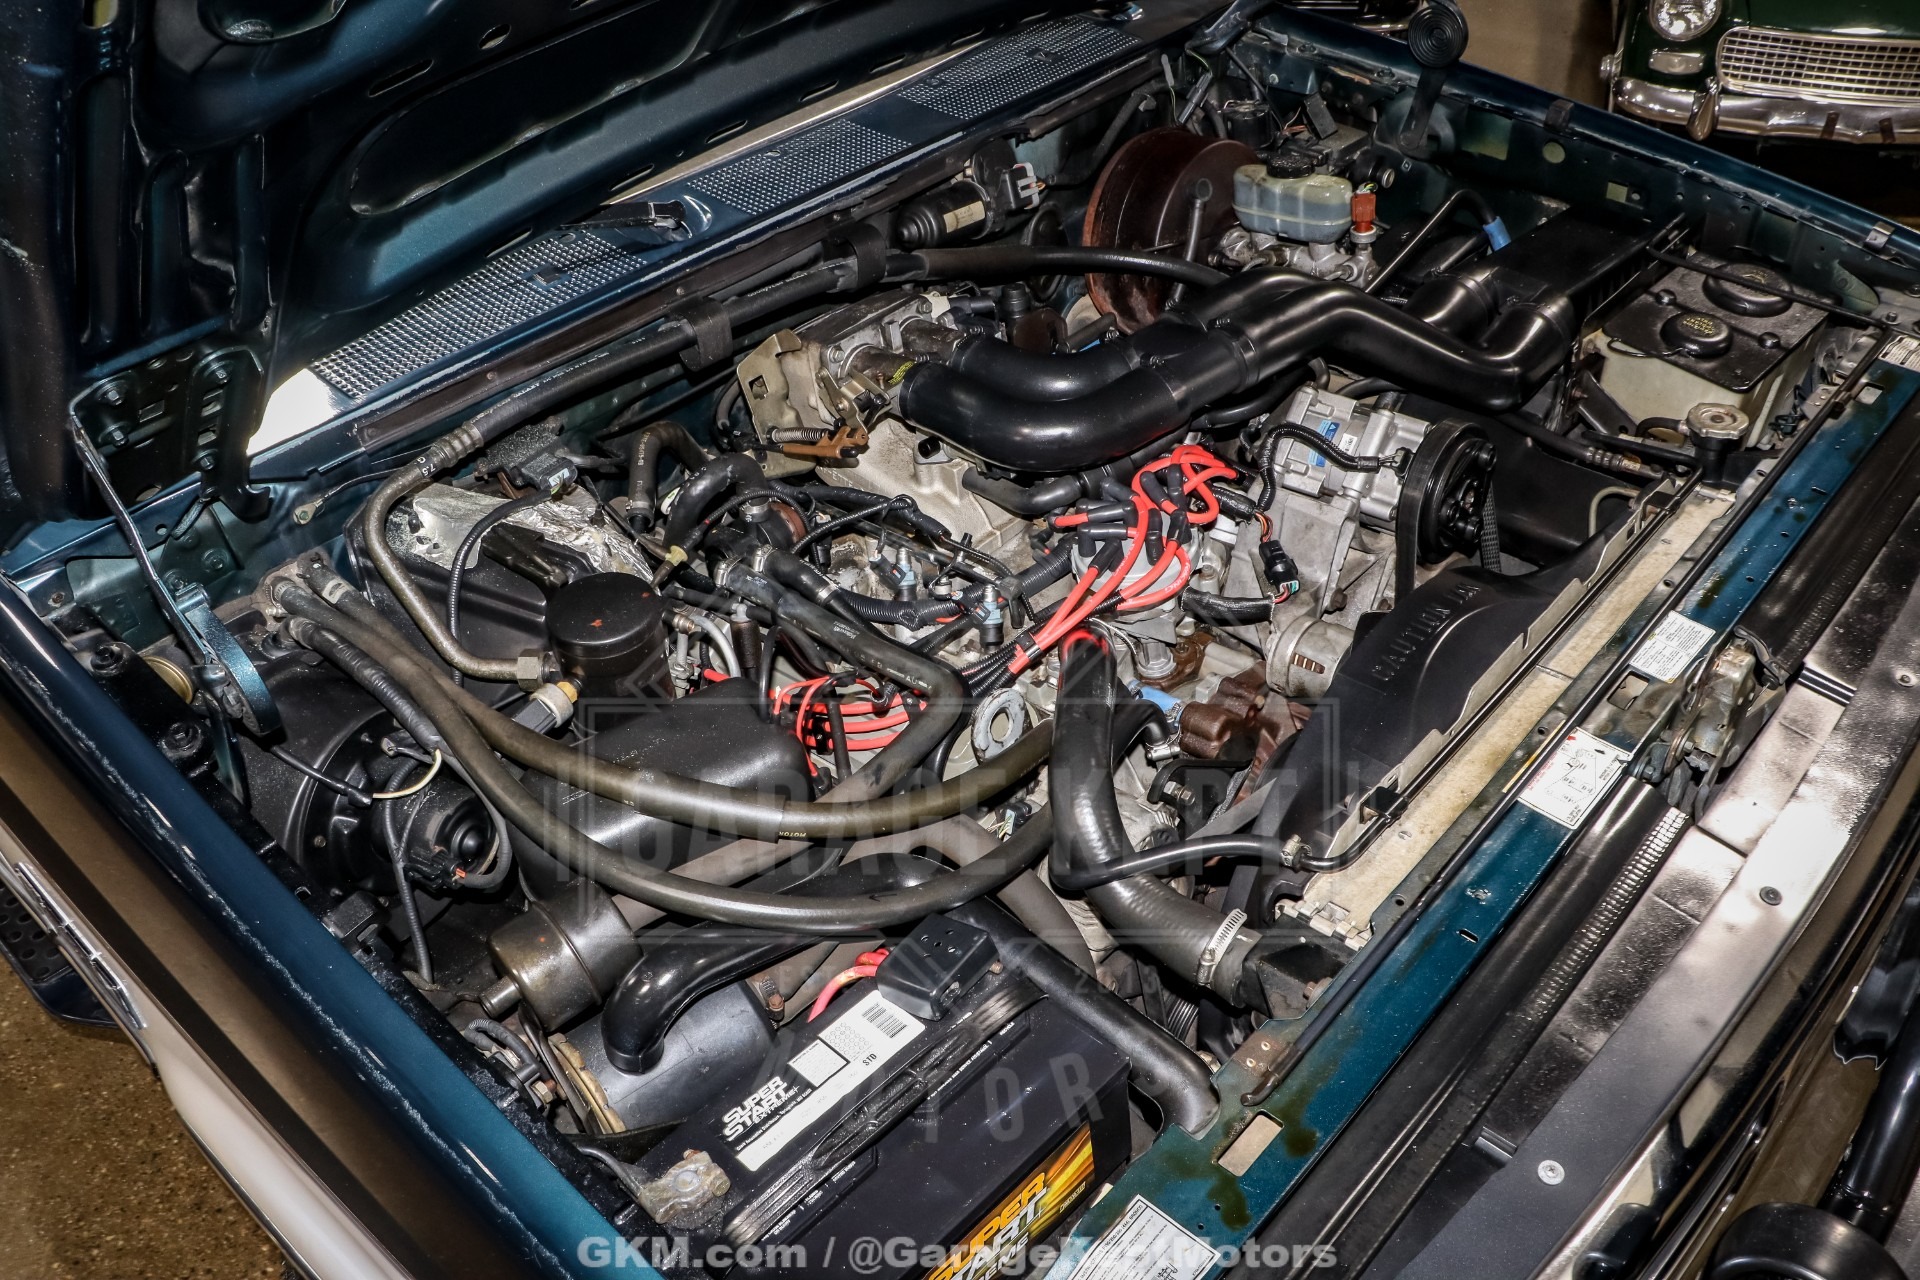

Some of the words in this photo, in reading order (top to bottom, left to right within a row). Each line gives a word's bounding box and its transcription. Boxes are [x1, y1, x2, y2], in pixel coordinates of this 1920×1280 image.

[862, 1053, 878, 1066] STD
[722, 1075, 784, 1125] SUPER
[722, 1082, 788, 1142] START
[951, 1186, 1048, 1280] TART
